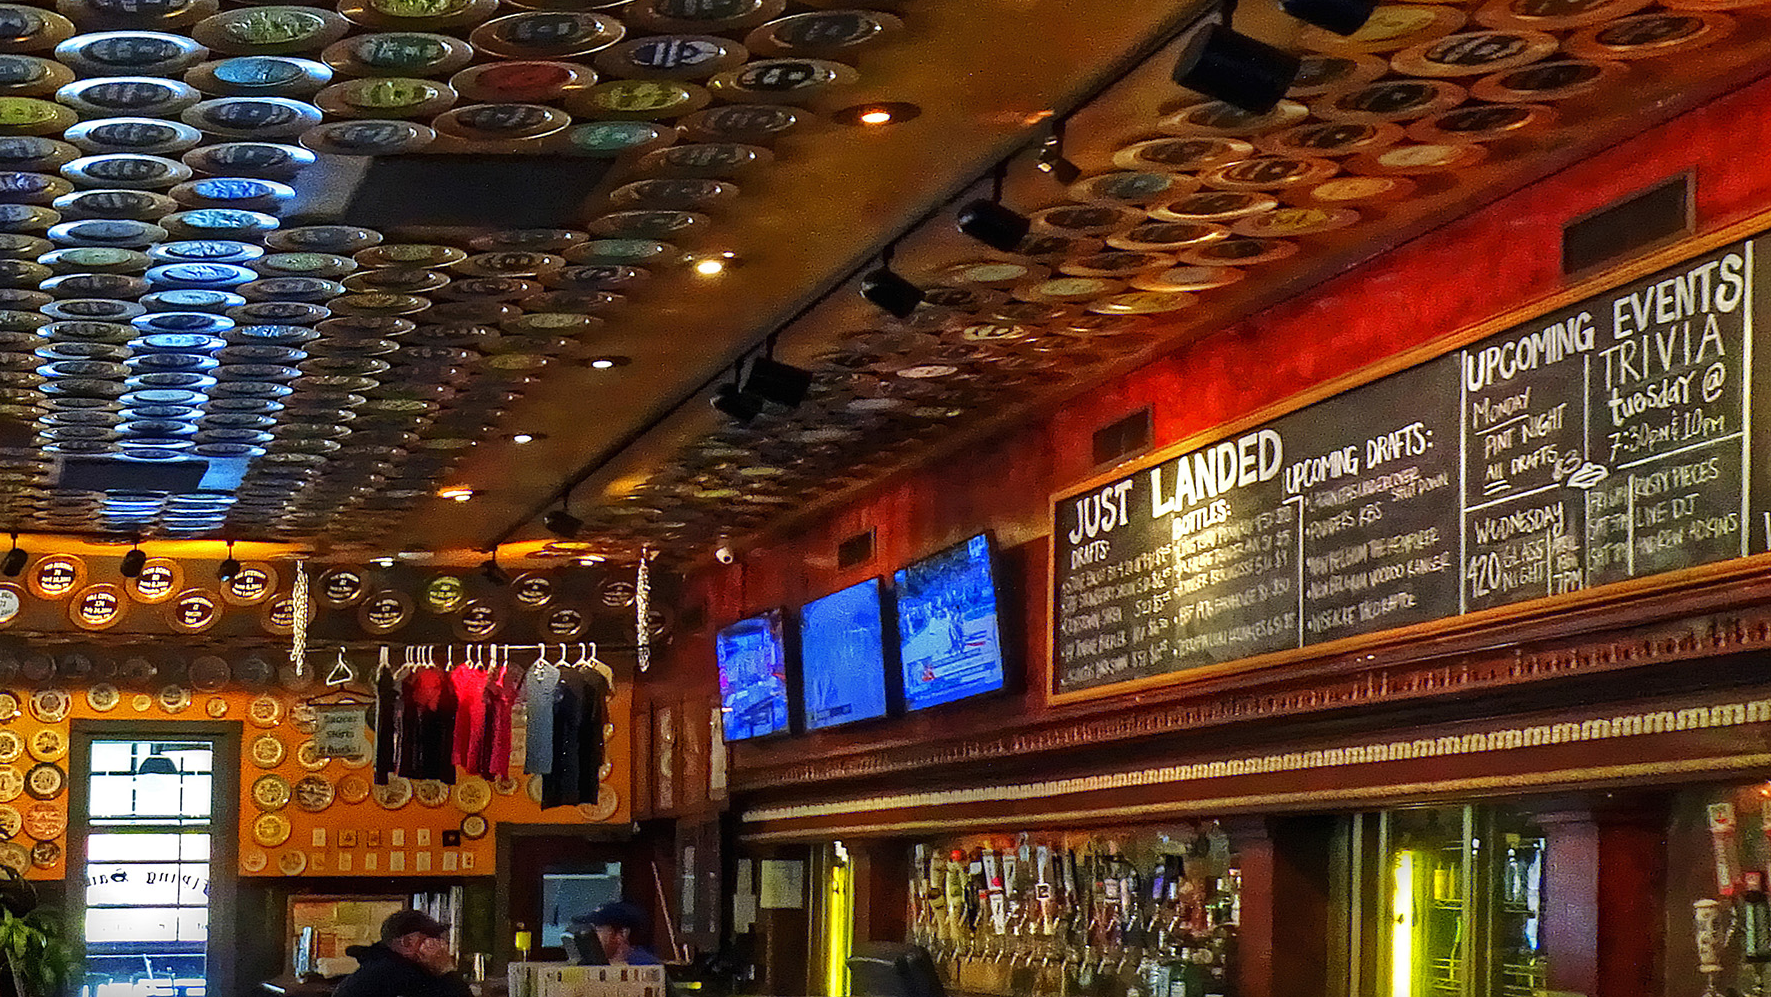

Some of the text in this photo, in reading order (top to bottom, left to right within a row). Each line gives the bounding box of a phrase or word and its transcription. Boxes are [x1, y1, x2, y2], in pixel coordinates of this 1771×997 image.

[1467, 253, 1743, 391] UPCOMING EVENTS
[1599, 313, 1726, 392] TRIVIA
[1522, 403, 1567, 443] NIGHT
[1286, 422, 1434, 494] UPCOMING DRAFTS:
[1511, 443, 1558, 475] DRAFTS
[1069, 429, 1284, 544] JUST LANDED
[1672, 493, 1700, 519] DJ
[1172, 499, 1232, 540] BOTTLES:
[1467, 552, 1500, 598] 420
